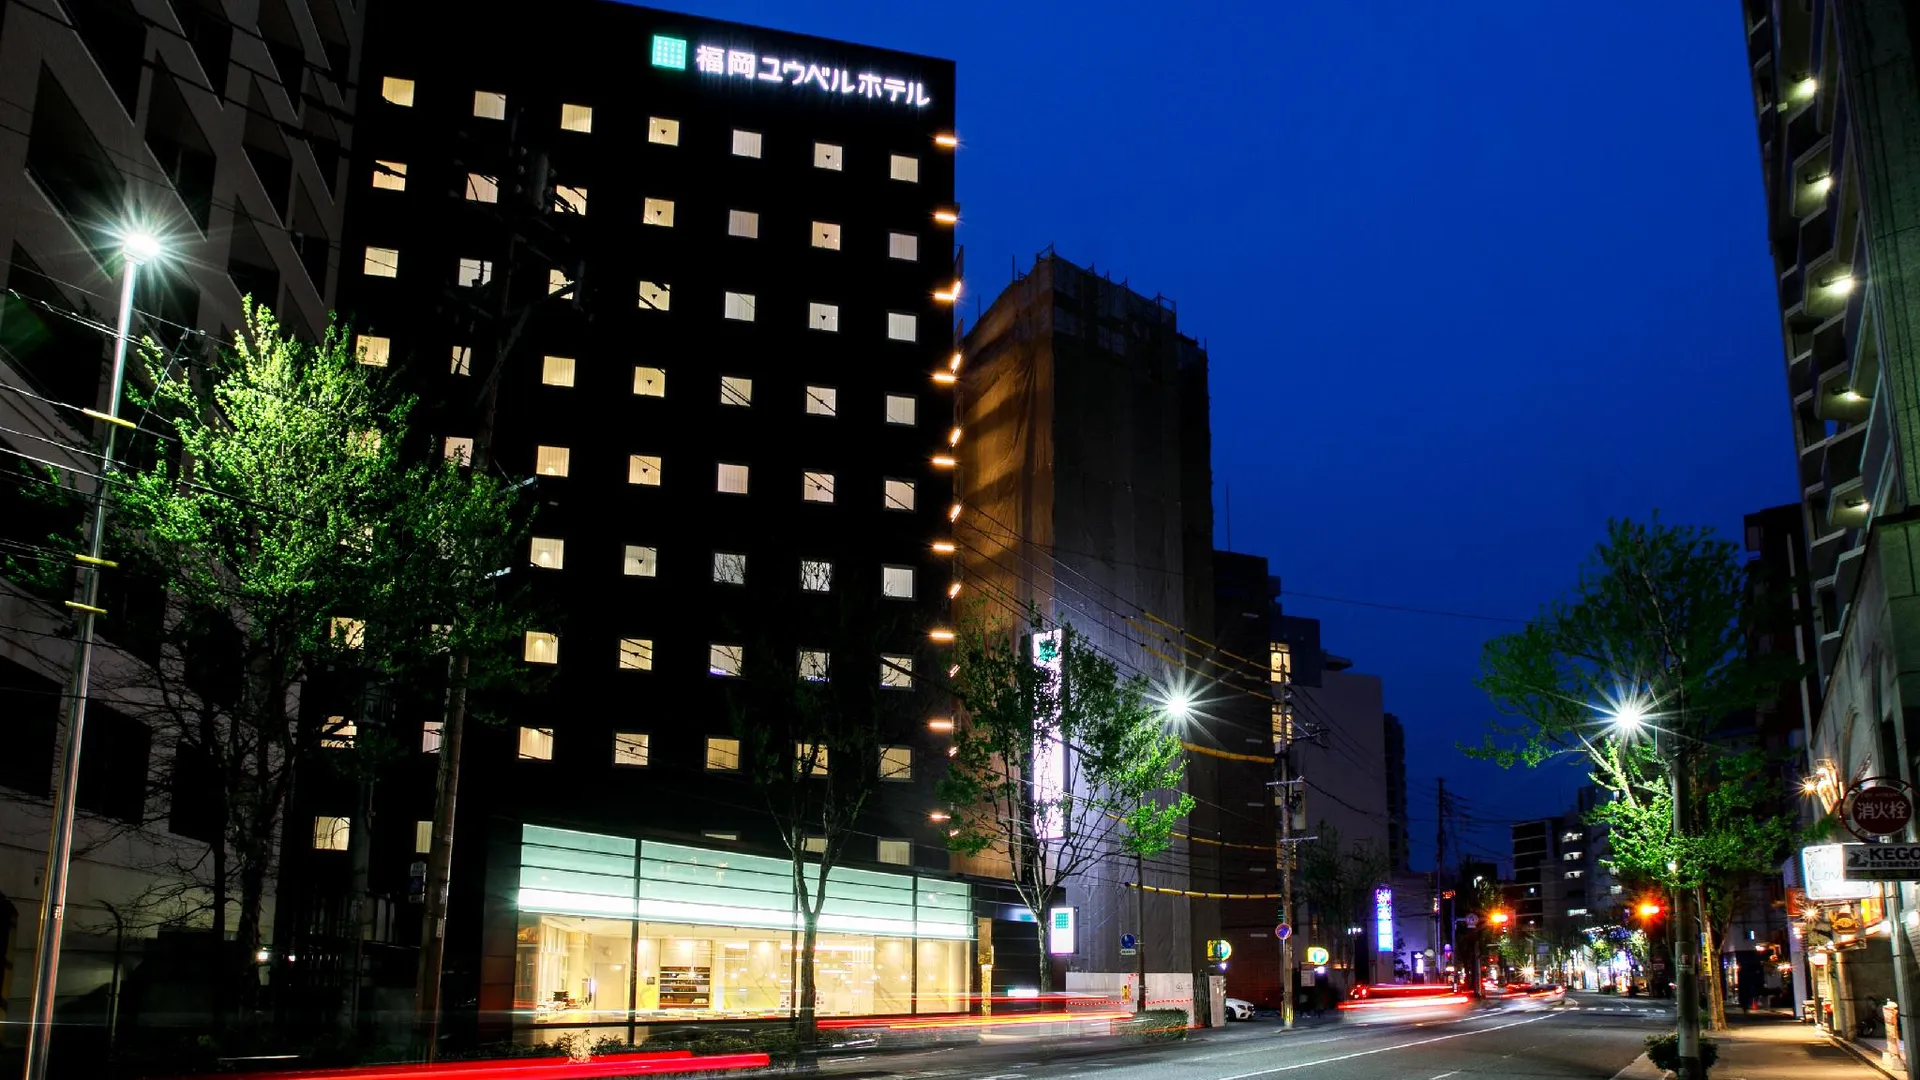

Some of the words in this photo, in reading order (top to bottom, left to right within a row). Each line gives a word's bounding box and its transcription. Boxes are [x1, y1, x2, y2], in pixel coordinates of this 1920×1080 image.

[696, 44, 930, 106] 福岡ユウベルホテル
[1857, 801, 1908, 820] 消火栓
